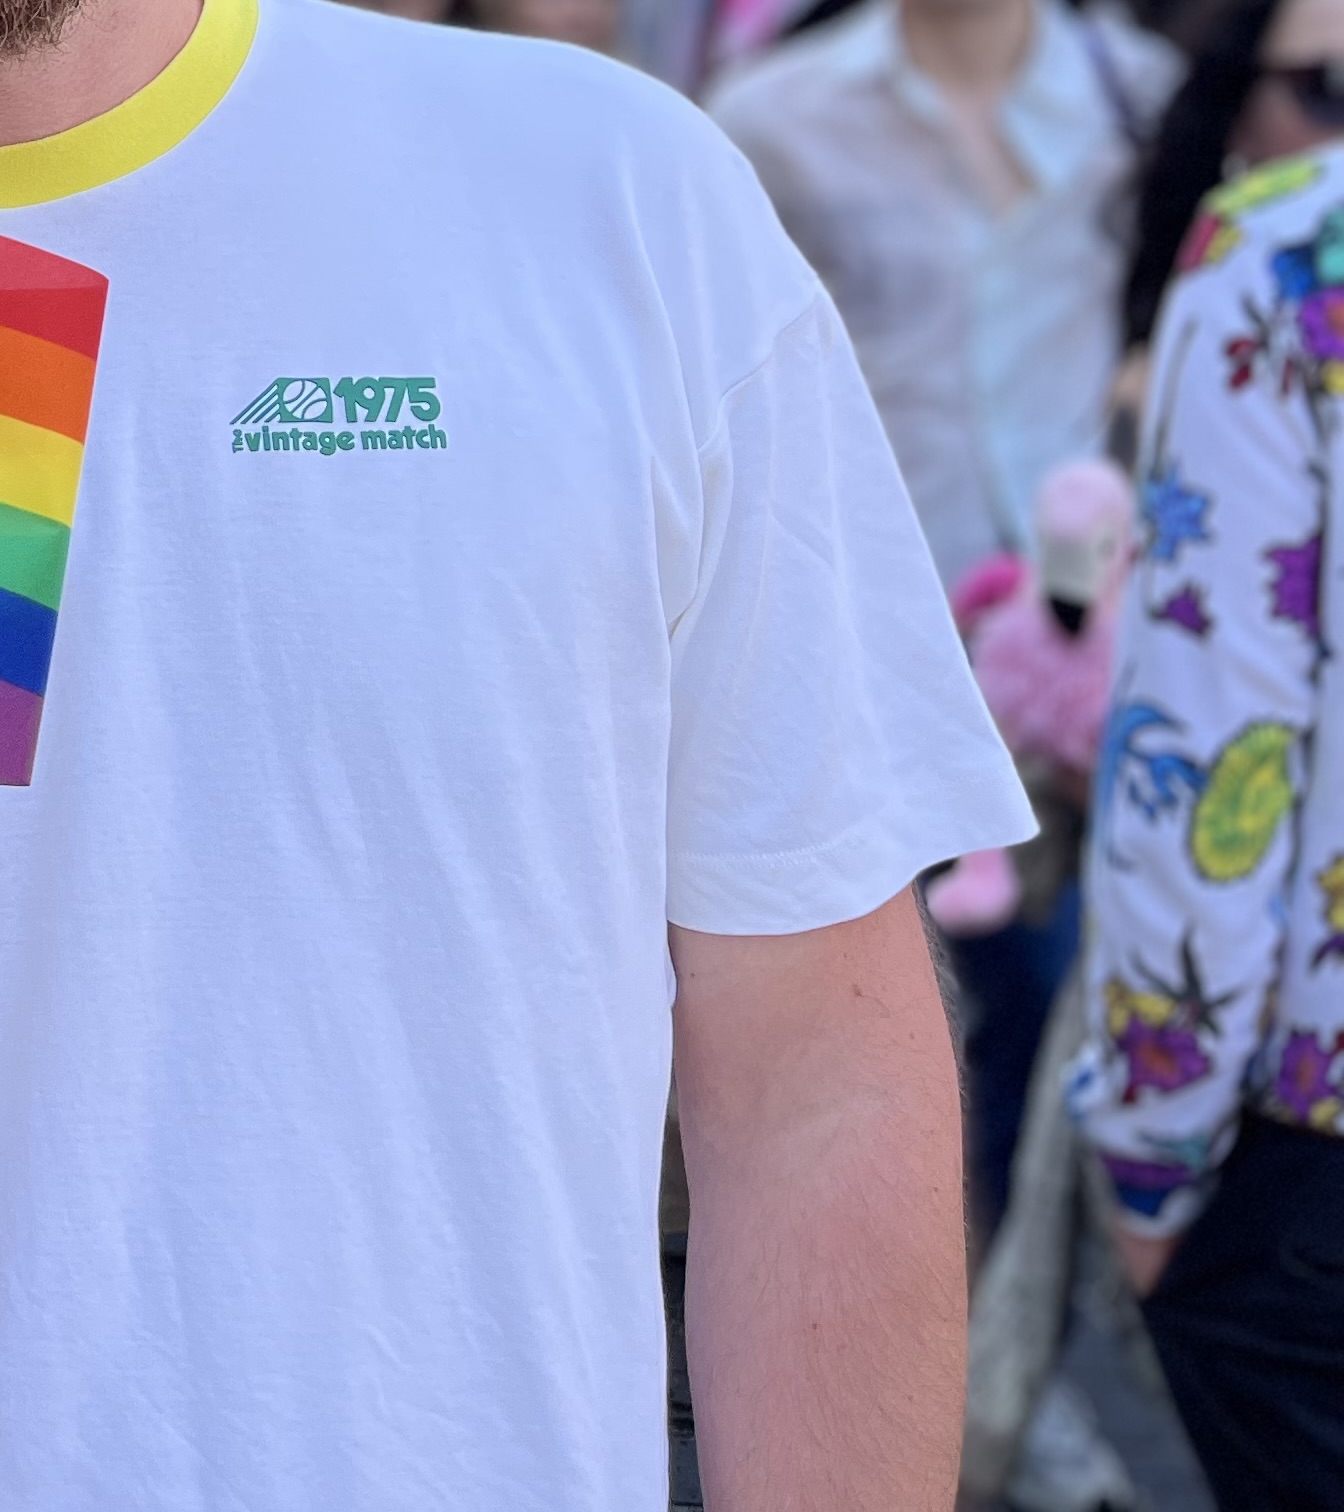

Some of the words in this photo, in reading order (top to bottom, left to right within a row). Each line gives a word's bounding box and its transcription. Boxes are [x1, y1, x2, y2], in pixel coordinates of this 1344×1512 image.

[333, 376, 441, 423] 1975
[244, 425, 355, 456] vintage
[360, 424, 448, 451] match
